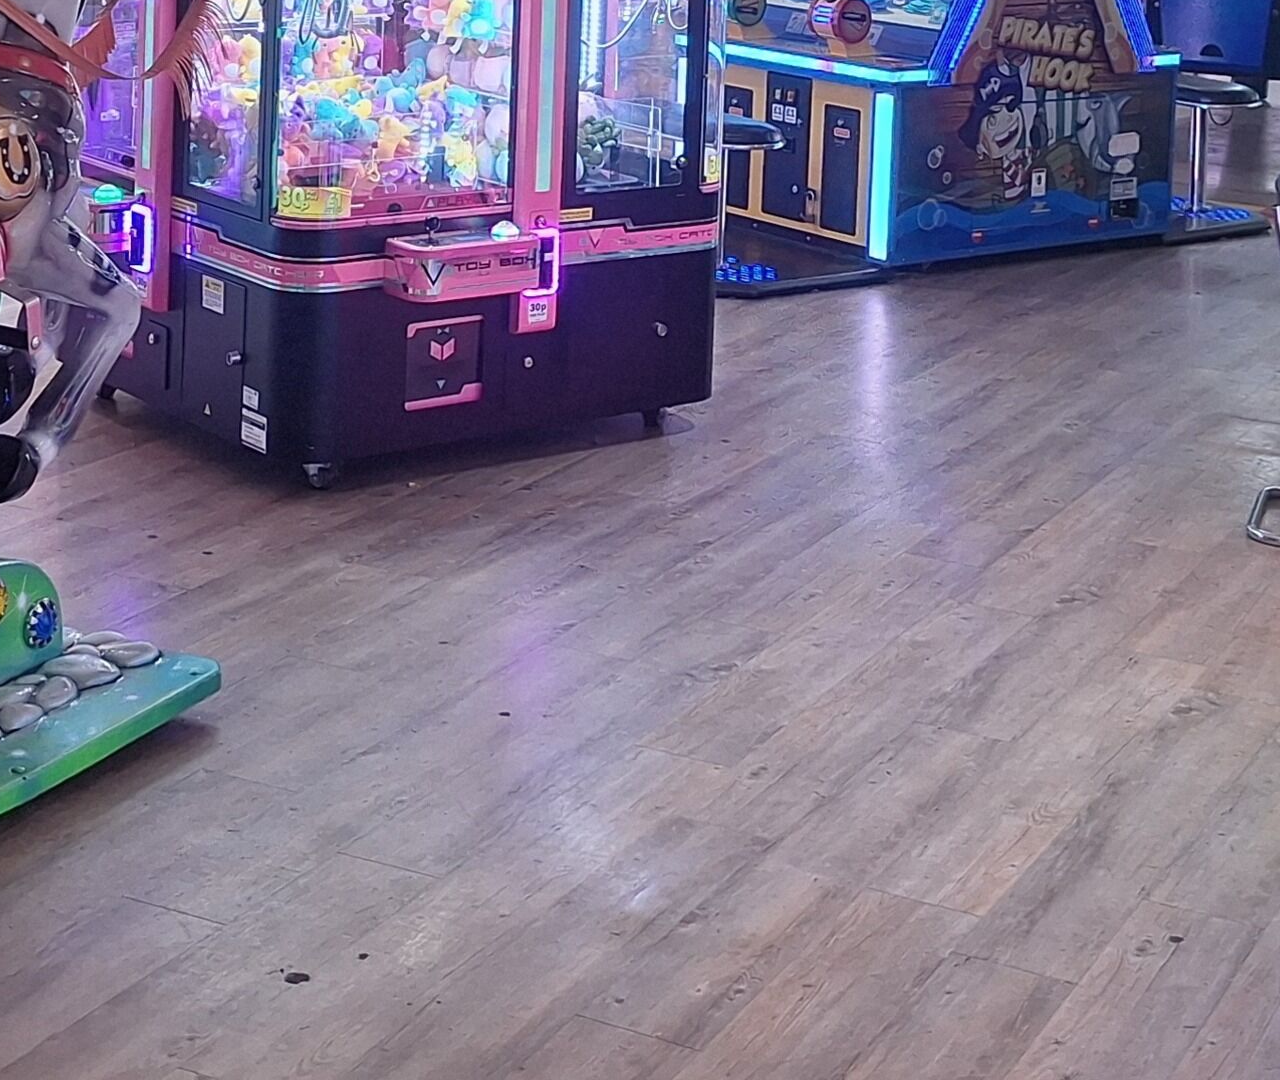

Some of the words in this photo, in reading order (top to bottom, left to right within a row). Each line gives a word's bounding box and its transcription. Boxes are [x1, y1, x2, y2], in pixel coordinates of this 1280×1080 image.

[998, 15, 1095, 60] PIRATE'S
[1029, 54, 1093, 93] HOOK
[454, 259, 492, 273] TOY
[529, 302, 548, 314] 30p
